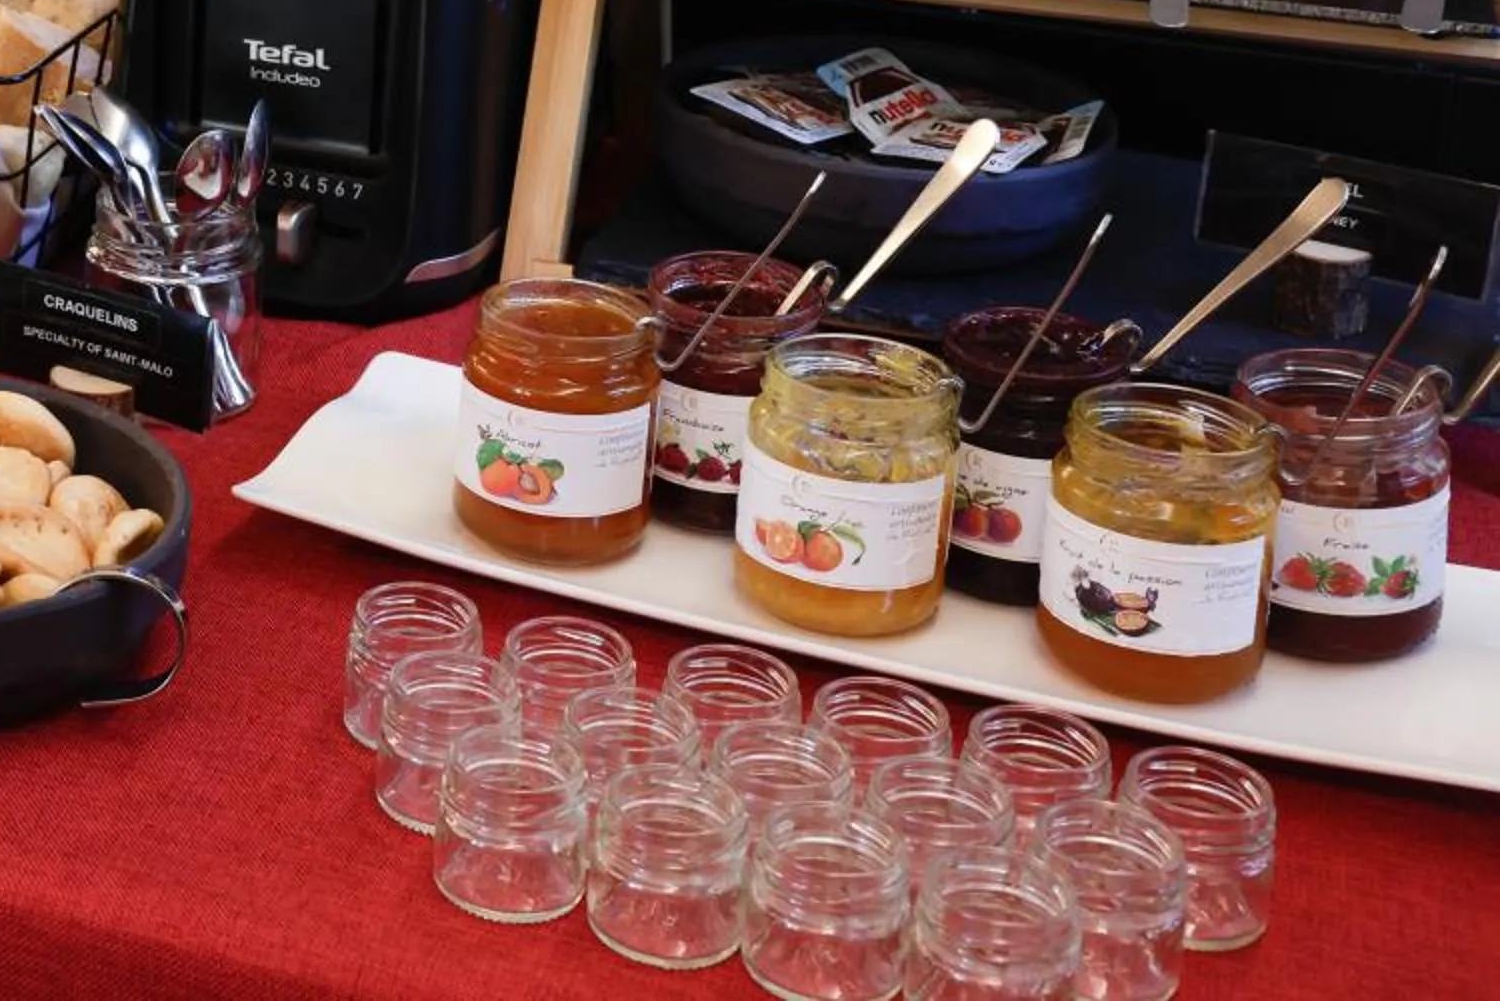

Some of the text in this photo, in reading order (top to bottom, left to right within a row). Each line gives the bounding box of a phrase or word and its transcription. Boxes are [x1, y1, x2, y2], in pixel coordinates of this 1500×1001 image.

[243, 38, 332, 71] Tefal
[250, 66, 321, 88] Includeo
[868, 87, 938, 125] nutella
[43, 293, 139, 333] CRAQUELINS
[22, 325, 174, 378] SPECIALTY OF SAINT-MALO
